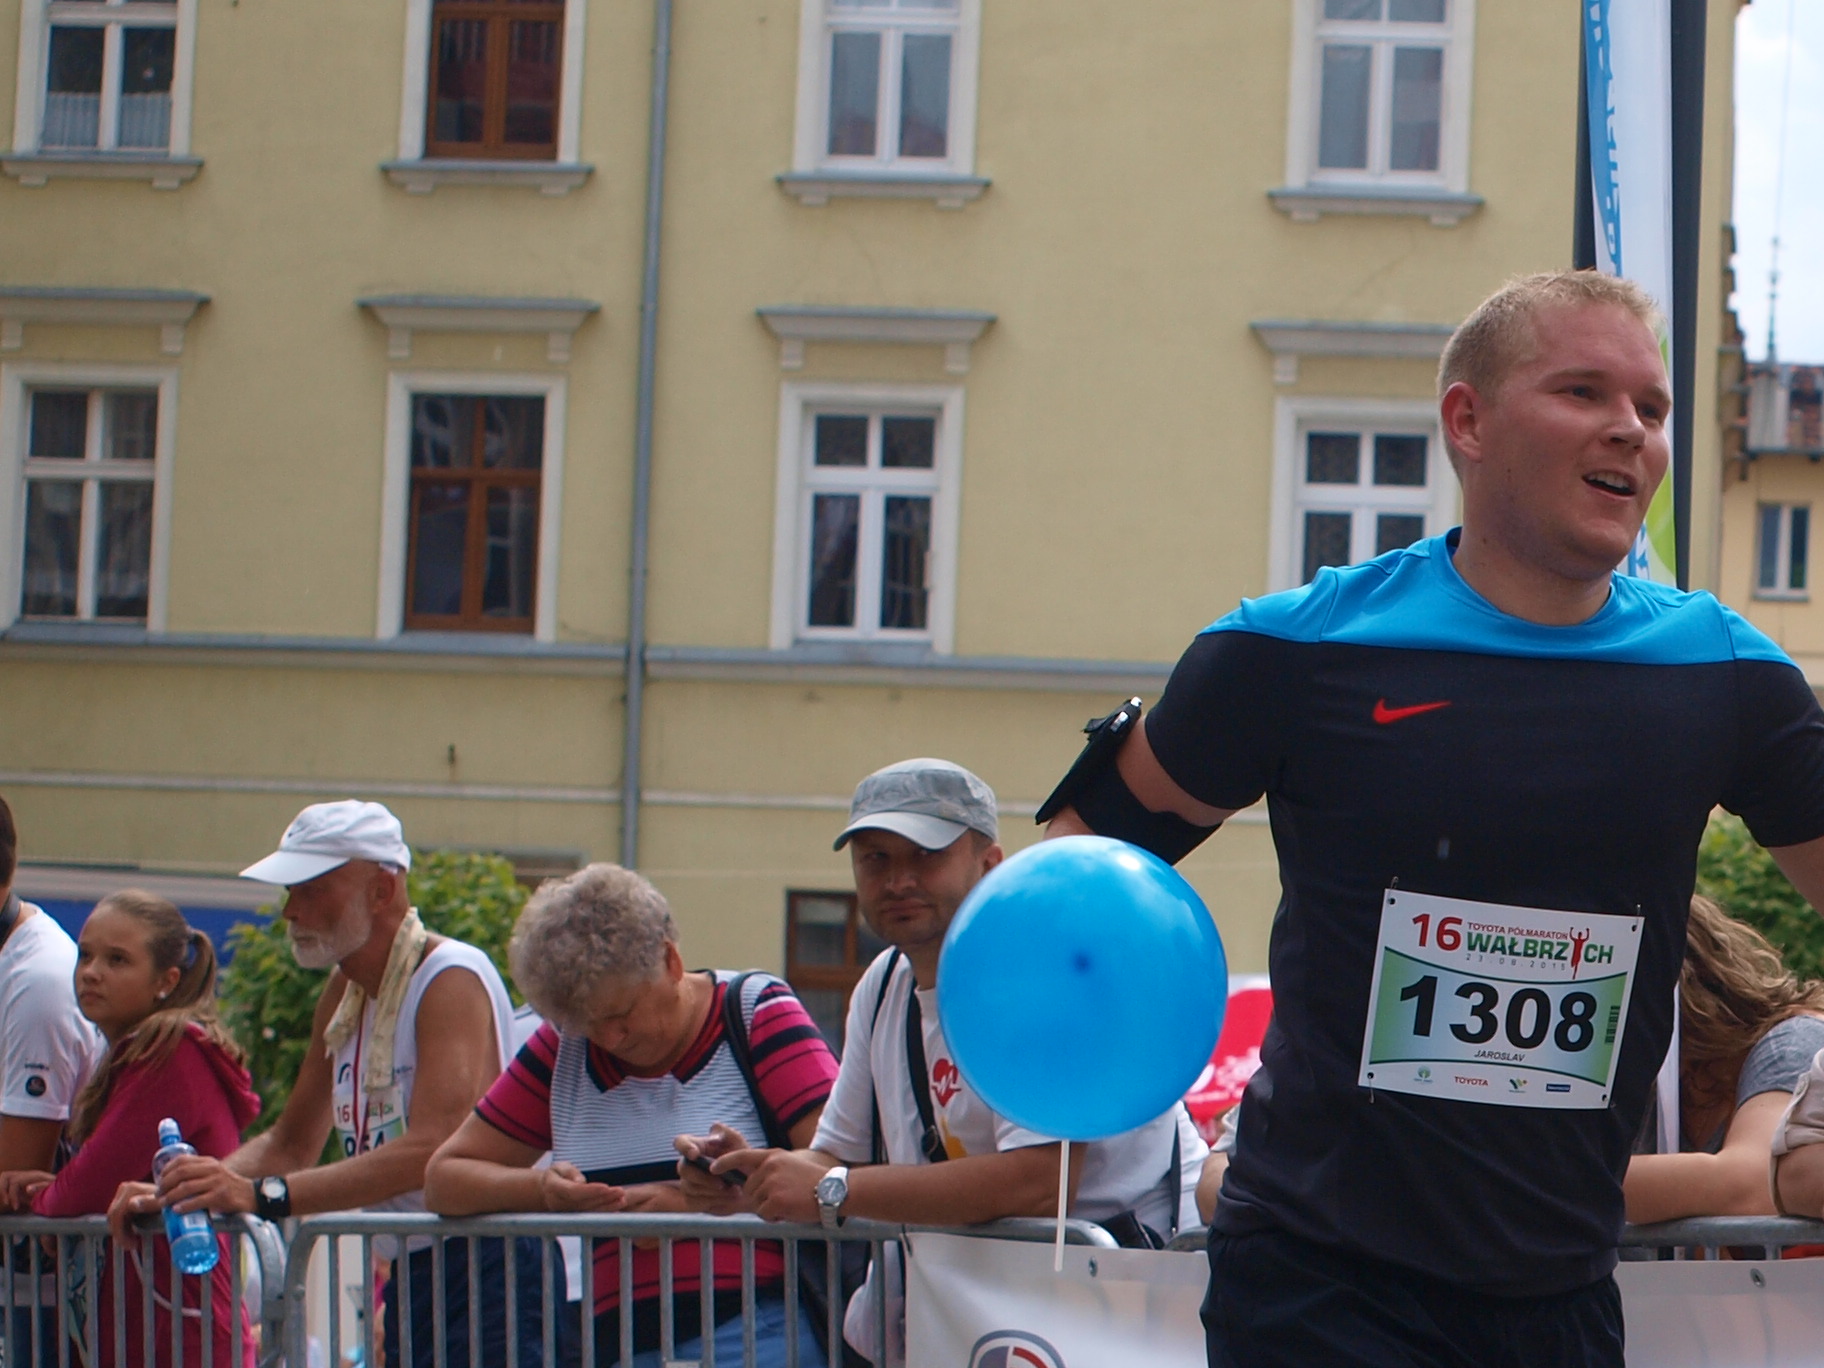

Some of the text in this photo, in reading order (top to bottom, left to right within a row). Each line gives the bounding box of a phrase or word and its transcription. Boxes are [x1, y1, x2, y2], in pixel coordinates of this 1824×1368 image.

[1412, 914, 1463, 951] 16
[1467, 921, 1568, 941] TOYOTA PÓŁMARATON
[1400, 975, 1598, 1053] 1308
[1474, 1050, 1526, 1062] JAROSLAV
[1454, 1076, 1489, 1087] TOYOTA
